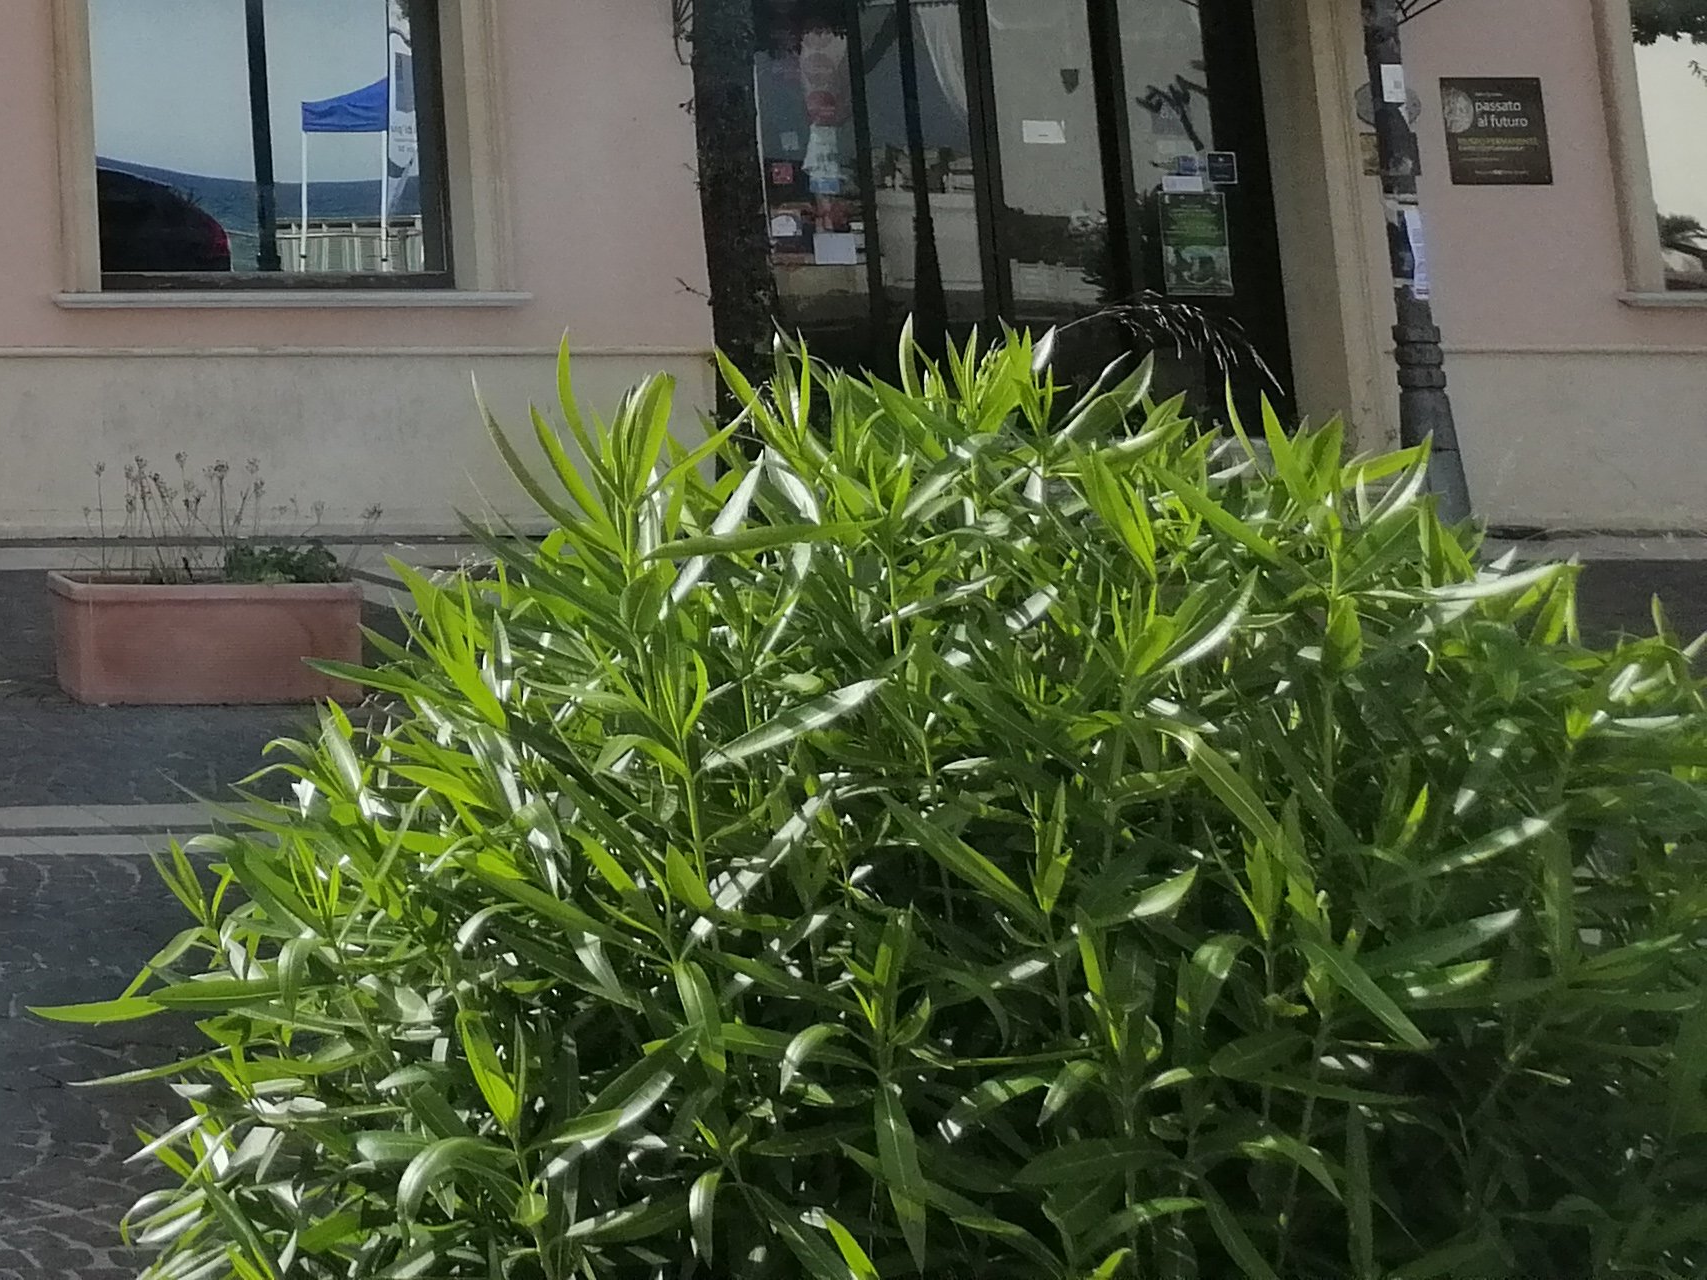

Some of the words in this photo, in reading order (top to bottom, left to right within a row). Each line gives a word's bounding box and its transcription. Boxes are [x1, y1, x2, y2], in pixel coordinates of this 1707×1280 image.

[1475, 101, 1522, 112] passato
[1477, 114, 1489, 128] al
[1491, 114, 1529, 128] futuro
